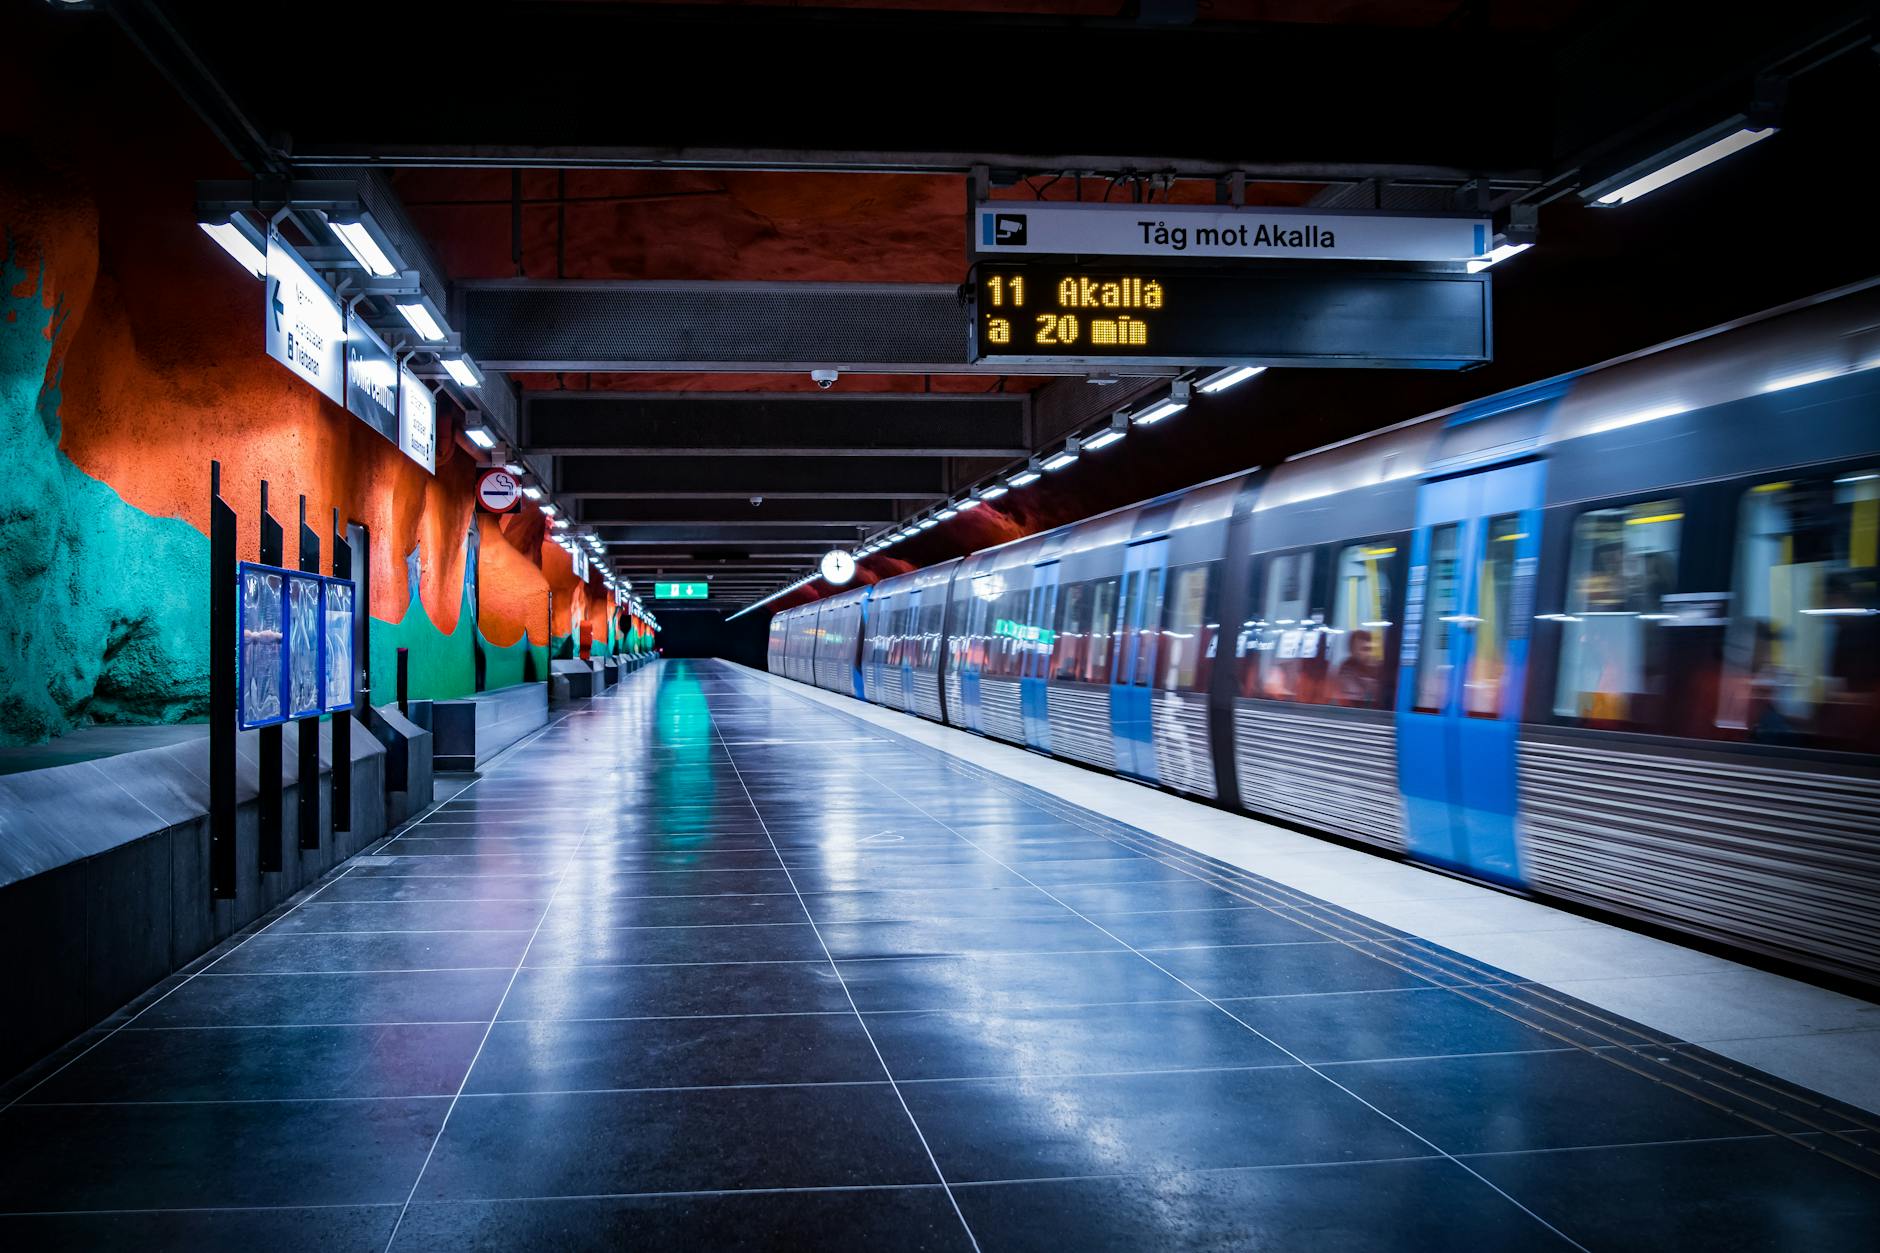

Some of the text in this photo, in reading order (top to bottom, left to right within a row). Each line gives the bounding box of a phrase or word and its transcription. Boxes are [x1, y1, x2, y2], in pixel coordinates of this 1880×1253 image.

[1138, 221, 1335, 250] Tåg mot Akalla
[987, 276, 1163, 309] 11 Akalla
[1036, 314, 1079, 344] 20
[1091, 315, 1147, 345] min
